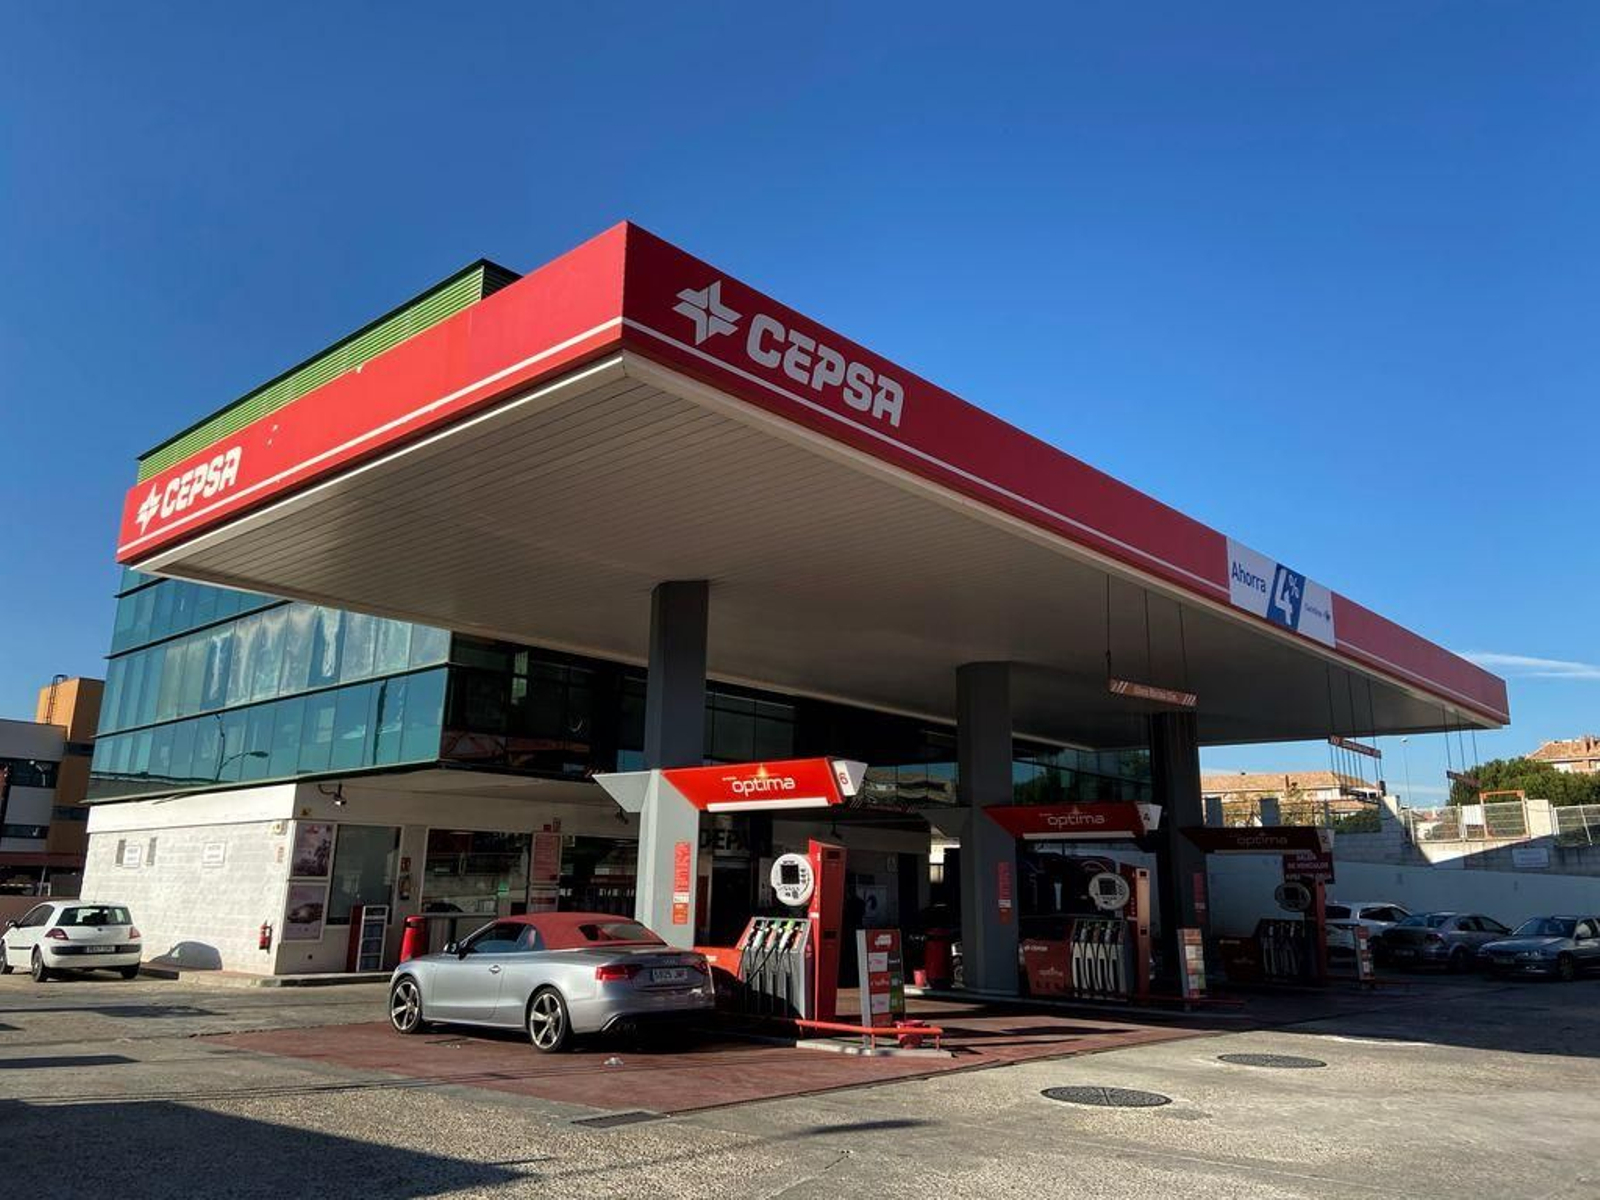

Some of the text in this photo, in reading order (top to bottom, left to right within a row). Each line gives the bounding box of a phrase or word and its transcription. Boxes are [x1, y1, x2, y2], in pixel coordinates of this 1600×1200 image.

[745, 313, 905, 428] CEPSA
[160, 446, 243, 519] CEPSA
[1231, 561, 1267, 594] Ahorra
[732, 777, 796, 797] optima
[839, 772, 849, 785] 6
[1047, 812, 1106, 831] optima
[1236, 835, 1288, 849] optima
